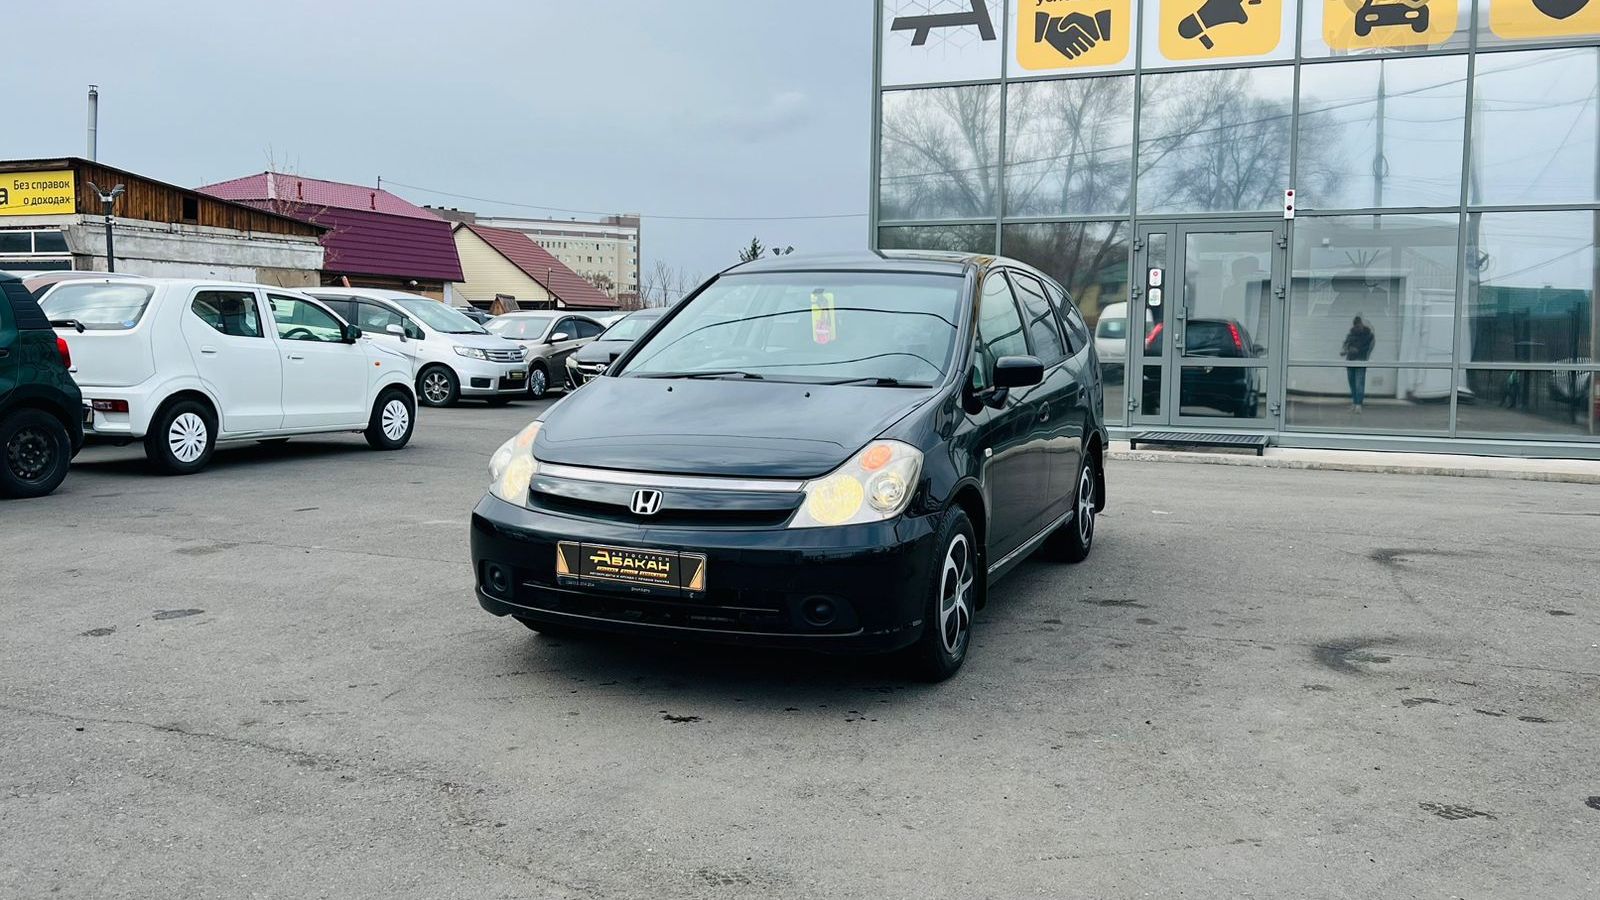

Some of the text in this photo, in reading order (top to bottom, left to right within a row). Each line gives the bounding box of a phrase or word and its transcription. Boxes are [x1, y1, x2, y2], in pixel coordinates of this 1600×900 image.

[13, 180, 70, 191] Без справок
[23, 196, 70, 206] о доходах
[589, 549, 670, 572] АБАКАН
